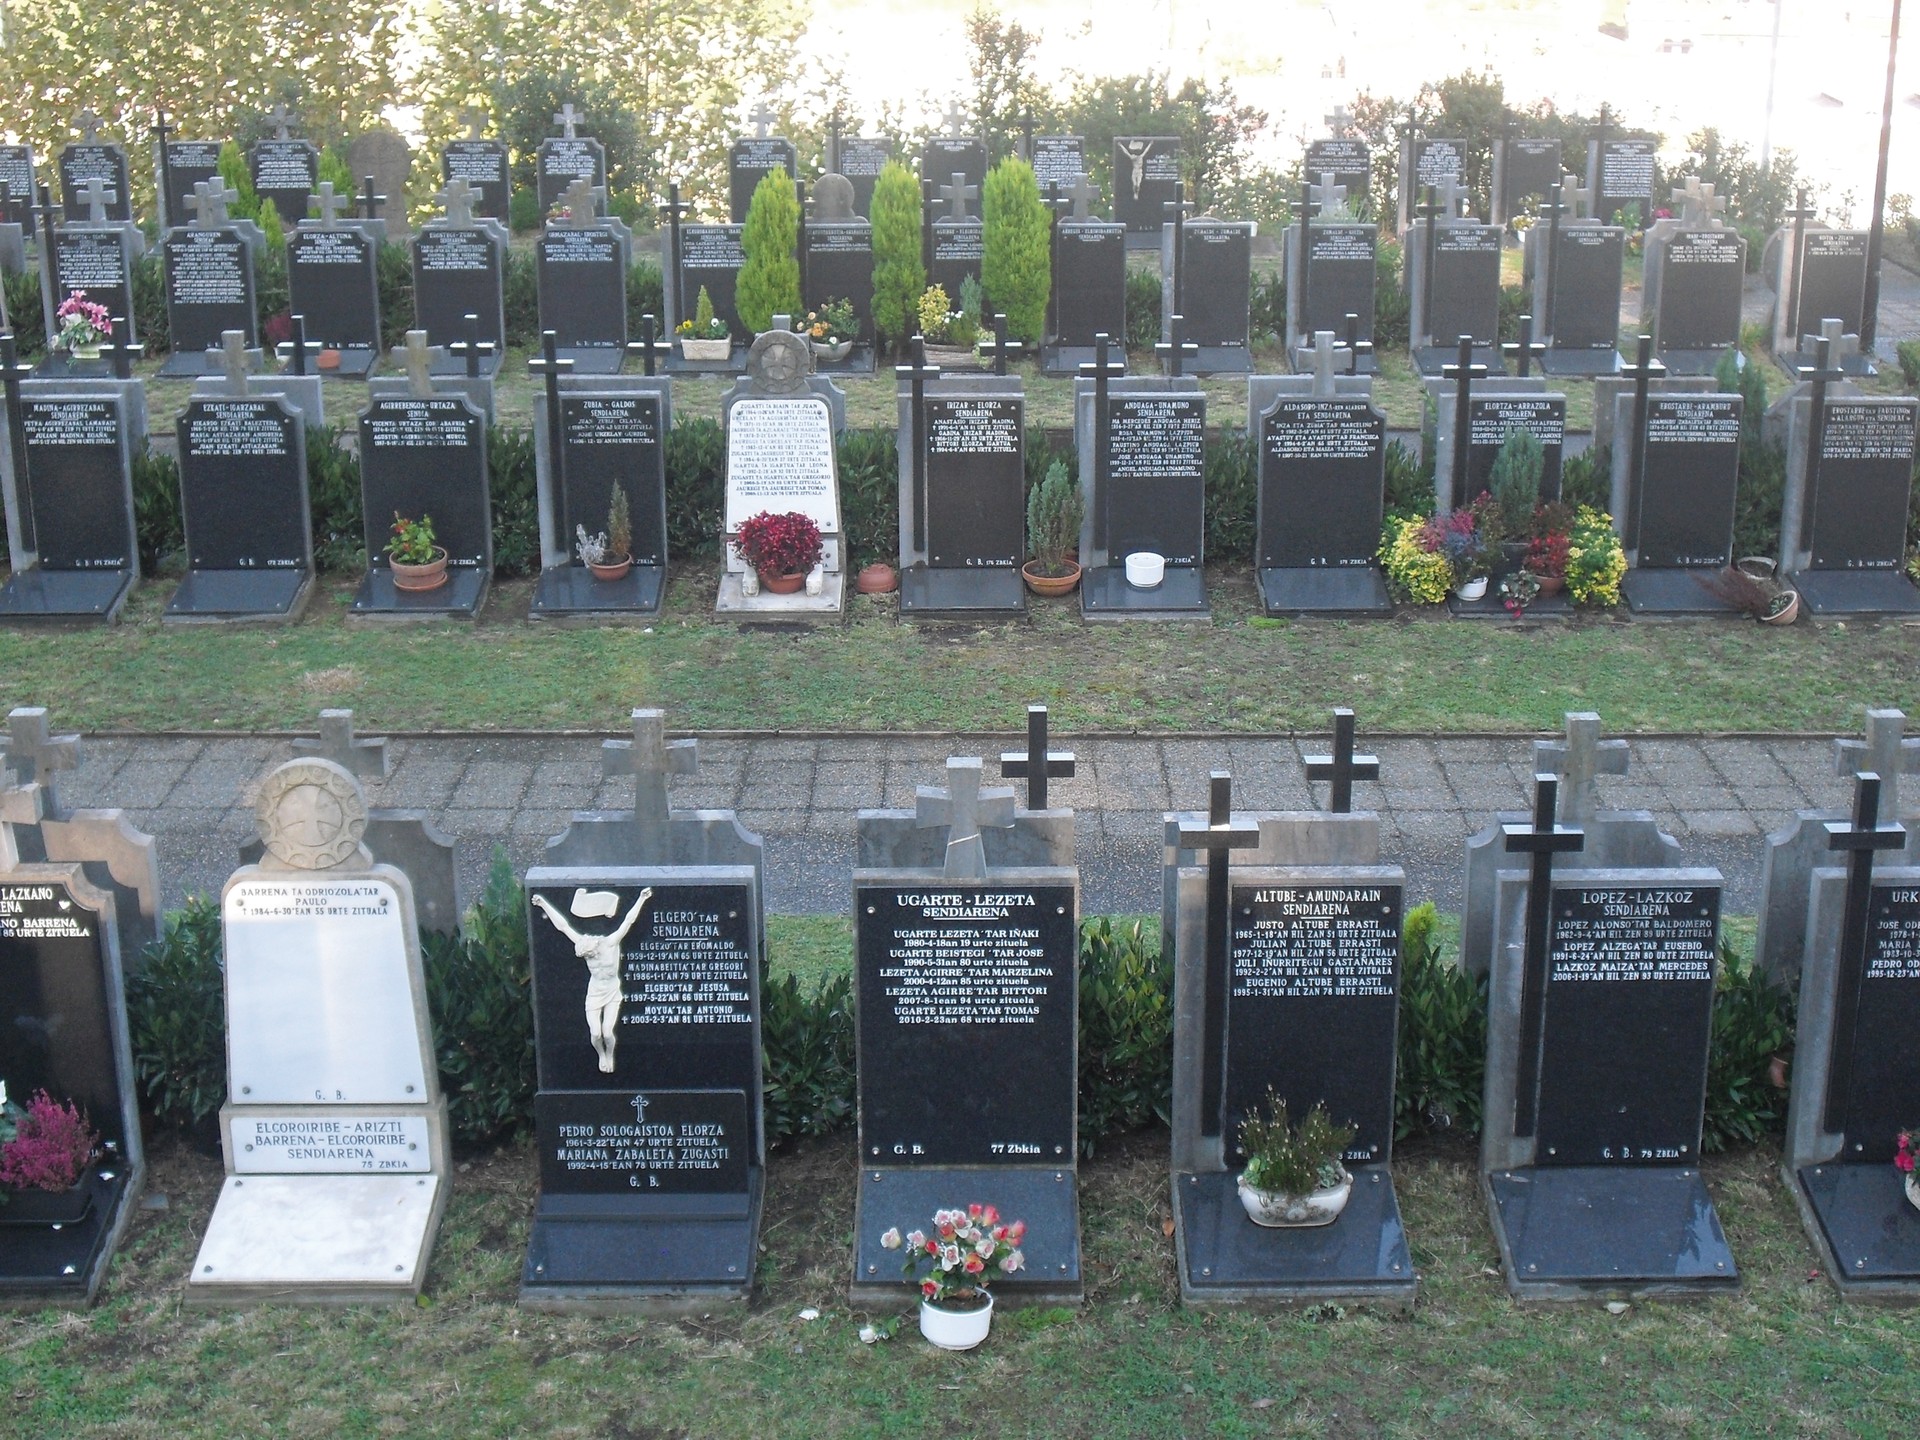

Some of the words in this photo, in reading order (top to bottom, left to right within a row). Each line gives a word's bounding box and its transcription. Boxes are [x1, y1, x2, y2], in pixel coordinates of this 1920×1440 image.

[1, 887, 53, 900] LAZKANO
[241, 888, 288, 896] BARRENA
[1255, 890, 1297, 902] ALTUBE
[1306, 890, 1381, 902] AMUNDARAIN
[897, 895, 962, 907] UGARTE
[974, 895, 1035, 906] LEZETA
[923, 908, 1009, 917] SENDIARENA
[1283, 904, 1350, 915] SENDIARENA
[1604, 905, 1670, 916] SENDIARENA
[23, 918, 77, 928] BARRENA
[1254, 921, 1284, 929] JUSTO
[1292, 921, 1330, 929] ALTUBE
[1337, 920, 1379, 929] ERRASTI
[1558, 921, 1589, 930] LOPEZ
[1654, 920, 1712, 929] BALDOMERO
[3, 929, 14, 937] 85
[16, 929, 44, 937] URTE
[46, 928, 90, 937] ZITUELA
[652, 926, 719, 937] SENDIARENA
[894, 930, 938, 938] UGARTE
[1009, 928, 1039, 938] IÑAKI
[1564, 942, 1595, 951] LOPEZ
[1664, 941, 1702, 950] EUSEBIO
[889, 949, 933, 958] UGARTE
[935, 949, 985, 958] BEISTEGI
[1016, 949, 1044, 958] JOSE
[709, 962, 744, 971] GREGORI
[1235, 959, 1257, 968] JULI
[1328, 956, 1393, 967] GASTAÑARES
[1557, 963, 1596, 972] LAZKOZ
[1659, 962, 1708, 971] MERCEDES
[880, 968, 920, 977] LEZETA
[992, 968, 1053, 976] MARZELINA
[1607, 972, 1620, 980] HIL
[1623, 972, 1639, 980] ZEN
[1642, 972, 1651, 980] 93
[1653, 972, 1674, 980] URTE
[1676, 971, 1711, 980] ZITUELA
[1246, 978, 1288, 987] EUGENIO
[1294, 978, 1333, 987] ALTUBE
[1340, 977, 1382, 986] ERRASTI
[699, 983, 729, 992] JESUSA
[886, 987, 928, 996] LEZETA
[1002, 987, 1047, 995] BITTORI
[1287, 987, 1301, 996] HIL
[1303, 987, 1320, 996] ZAN
[1323, 987, 1332, 996] 78
[1335, 987, 1356, 996] URTE
[1359, 987, 1394, 995] ZITUELA
[697, 1005, 733, 1015] ANTONIO
[894, 1007, 936, 1015] UGARTE
[1004, 1006, 1040, 1015] TOMAS
[682, 1015, 691, 1024] 81
[693, 1015, 714, 1024] URTE
[717, 1014, 752, 1024] ZITUELA
[961, 1016, 972, 1024] 68
[975, 1016, 996, 1024] urte
[1000, 1016, 1034, 1024] zituela
[256, 1123, 340, 1133] ELCOROIRIBE
[354, 1122, 401, 1133] ARIZTI
[559, 1126, 594, 1137] PEDRO
[600, 1126, 674, 1137] SOLOGAISTOA
[682, 1125, 724, 1136] ELORZA
[634, 1139, 644, 1147] 47
[648, 1139, 673, 1147] URTE
[676, 1138, 718, 1147] ZITUELA
[288, 1149, 374, 1159] SENDIARENA
[991, 1144, 1003, 1154] 77
[1007, 1144, 1041, 1154] Zbkia
[1641, 1150, 1652, 1158] 79
[1656, 1150, 1679, 1158] ZBKIA
[557, 1149, 608, 1161] MARIANA
[615, 1149, 674, 1160] ZABALETA
[682, 1148, 729, 1160] ZUGASTI
